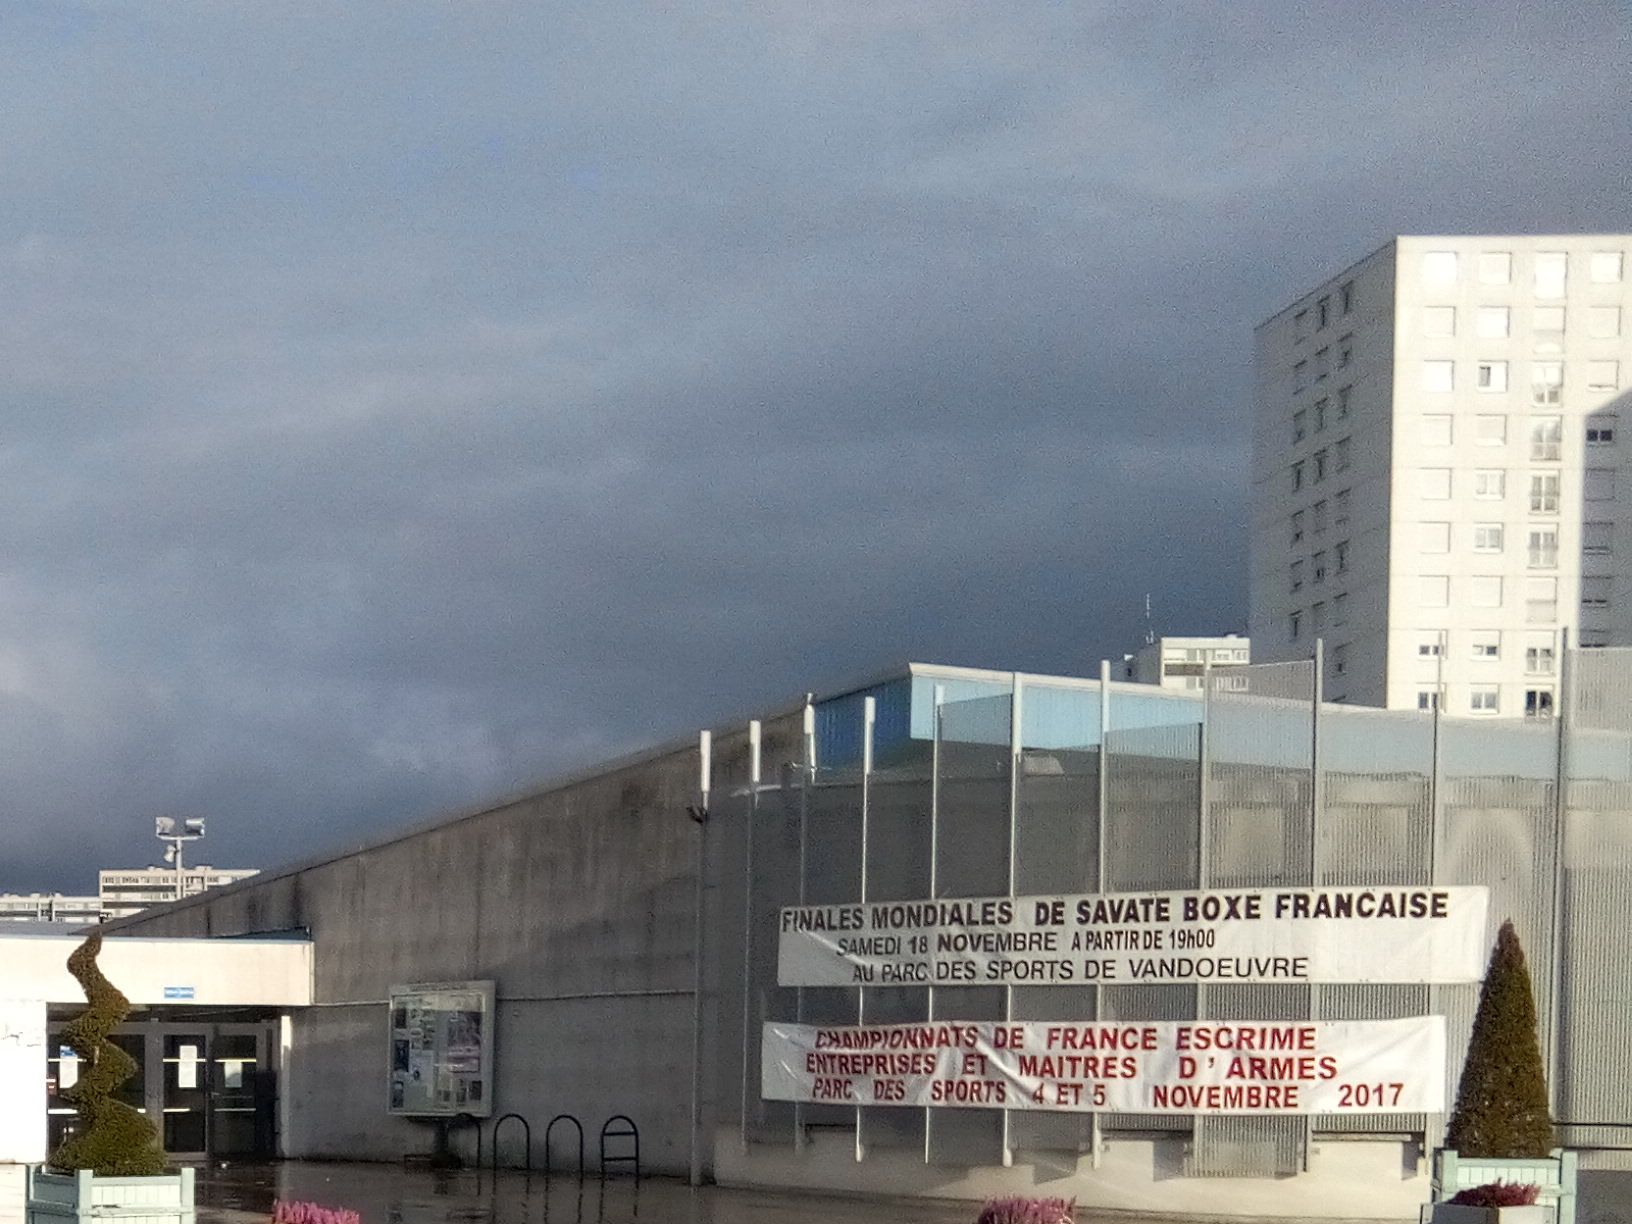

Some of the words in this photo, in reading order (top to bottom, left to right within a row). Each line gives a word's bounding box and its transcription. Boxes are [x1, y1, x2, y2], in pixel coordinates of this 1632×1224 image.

[782, 907, 864, 932] FINALES
[871, 901, 1013, 929] MONDIALES
[1035, 901, 1065, 926] DE
[1076, 898, 1170, 925] SAVATE
[1183, 895, 1261, 922] BOXE
[1275, 893, 1448, 919] FRANCAISE
[836, 935, 901, 957] SAMEDI
[907, 935, 928, 954] 18
[937, 932, 1057, 953] NOVEMBRE
[1071, 931, 1081, 951] A
[1085, 930, 1139, 951] PARTIR
[1143, 930, 1163, 950] DE
[1169, 928, 1215, 949] 19h00
[852, 964, 874, 982] AU
[881, 962, 928, 982] PARC
[936, 961, 976, 980] DES
[986, 960, 1073, 980] SPORTS
[1085, 959, 1116, 979] DE
[1128, 957, 1309, 978] VANDOEUVRE
[815, 1026, 979, 1050] CHAMPIONNATS
[993, 1027, 1024, 1049] DE
[1047, 1027, 1158, 1050] FRANCE
[1175, 1027, 1316, 1050] ESCRIME
[806, 1053, 936, 1075] ENTREPRISES
[962, 1054, 988, 1075] ET
[1019, 1055, 1137, 1079] MAITRES
[812, 1078, 852, 1099] PARC
[874, 1079, 905, 1100] DES
[931, 1080, 1006, 1103] SPORTS
[1032, 1082, 1045, 1105] 4
[1056, 1083, 1083, 1105] ET
[1093, 1084, 1105, 1105] 5
[1153, 1085, 1299, 1108] NOVEMBRE
[1338, 1083, 1404, 1107] 2017
